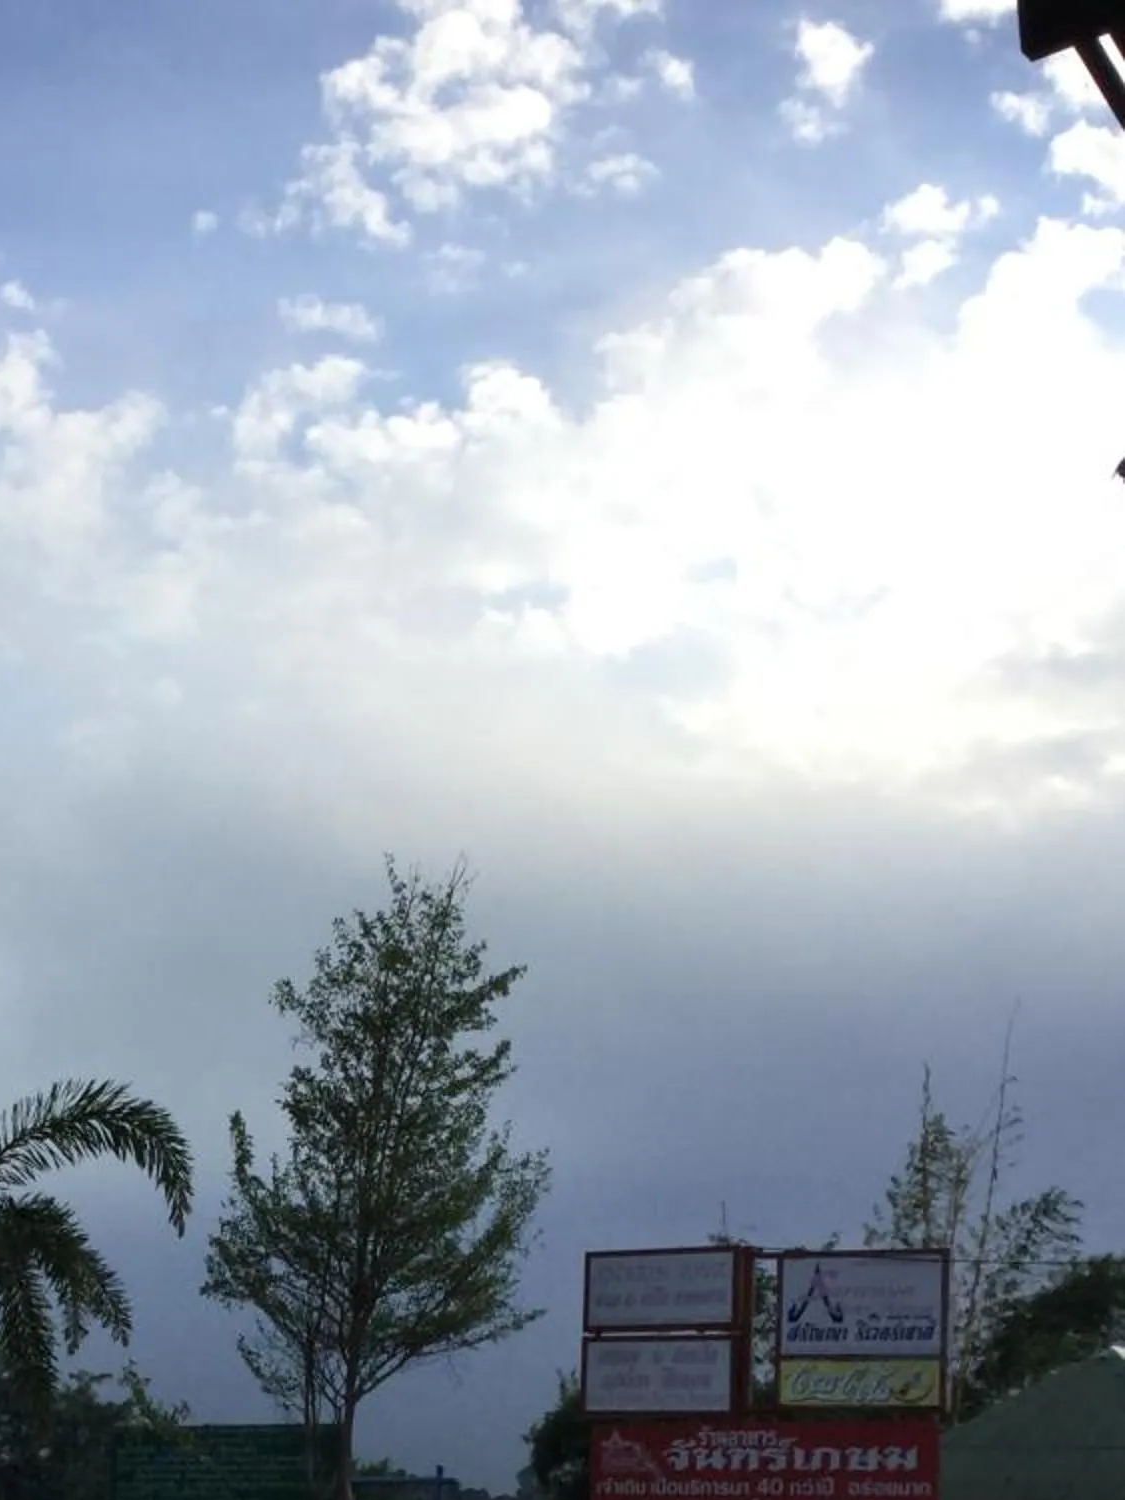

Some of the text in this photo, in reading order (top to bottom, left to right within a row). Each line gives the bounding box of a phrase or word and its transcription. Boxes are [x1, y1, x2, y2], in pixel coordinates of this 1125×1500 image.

[697, 1426, 778, 1446] ร้านอาหาร
[664, 1436, 918, 1472] จันทร์เกษม
[755, 1478, 784, 1494] 40
[789, 1475, 834, 1495] กว่าปี
[847, 1478, 931, 1496] อร่อยมาก
